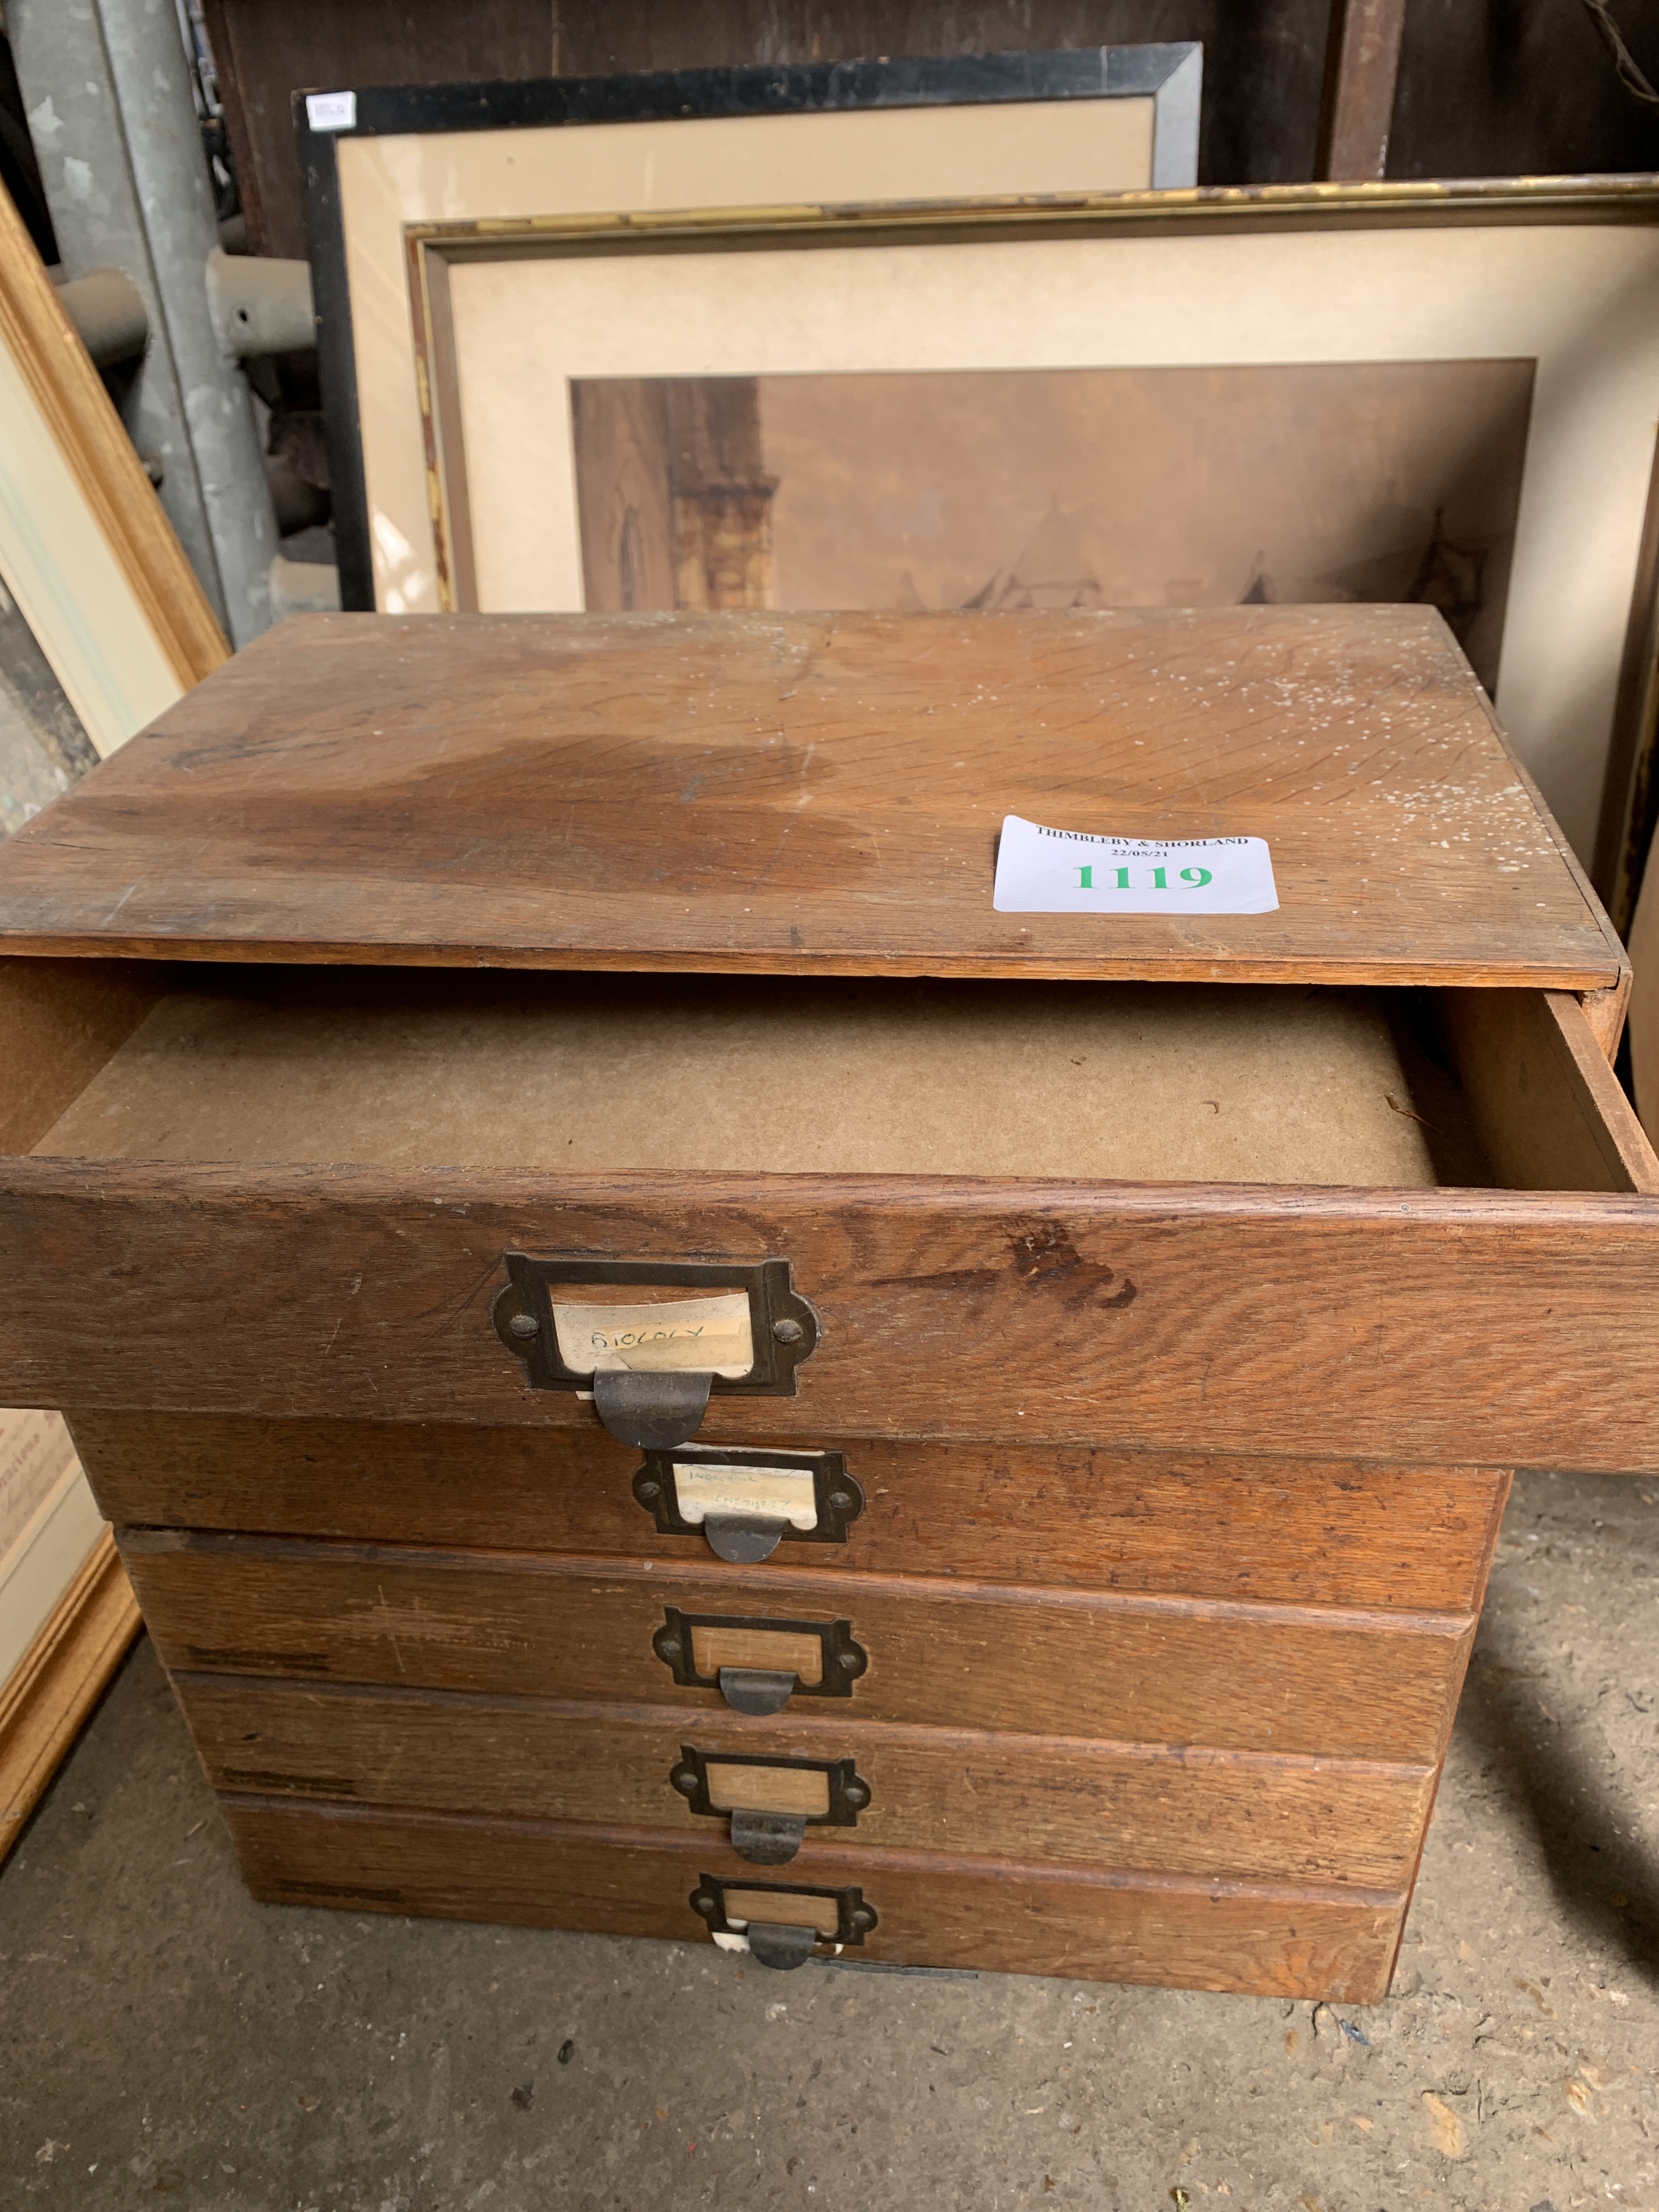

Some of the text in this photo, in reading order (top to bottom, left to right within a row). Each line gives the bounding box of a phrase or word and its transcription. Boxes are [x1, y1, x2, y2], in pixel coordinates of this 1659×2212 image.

[1036, 825, 1132, 847] THIMBLEBY
[1155, 838, 1249, 848] SHORLAND
[1110, 849, 1169, 857] 22/05/21
[1073, 865, 1213, 889] 1119
[715, 1494, 791, 1509] CHEMISTRY
